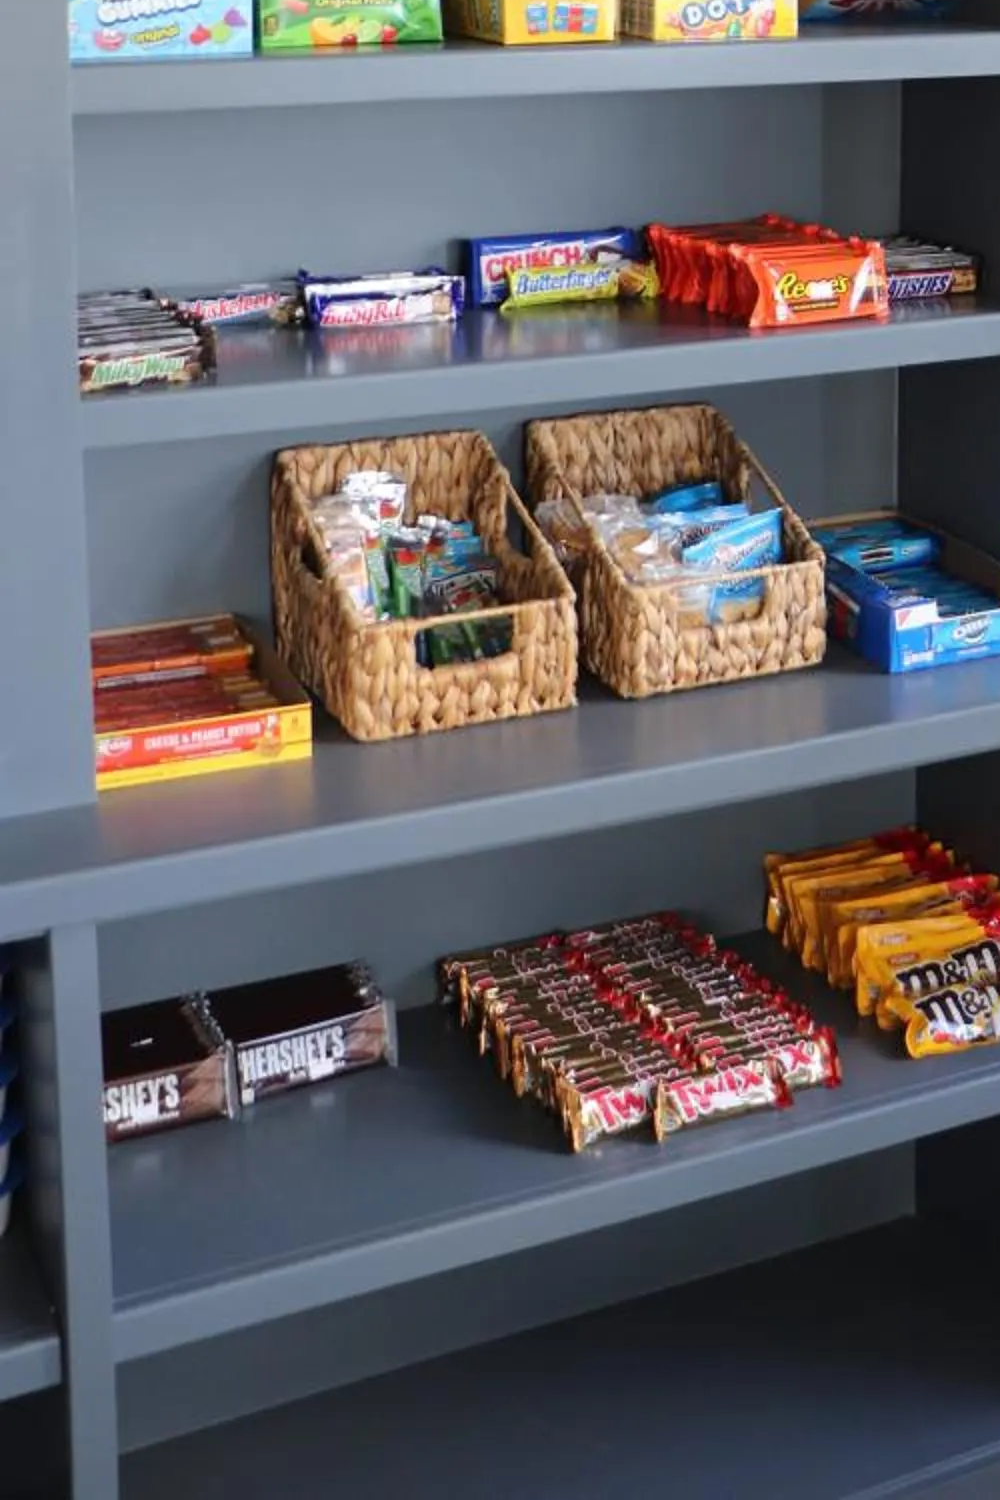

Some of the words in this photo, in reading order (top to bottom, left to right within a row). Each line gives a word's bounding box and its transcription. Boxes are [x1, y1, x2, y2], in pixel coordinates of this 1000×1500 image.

[485, 245, 581, 282] CRUNCH
[239, 1025, 346, 1083] HERSHEY'S
[102, 1073, 180, 1123] SHEY'S
[584, 1085, 647, 1134] Tw
[668, 1068, 765, 1122] Twix
